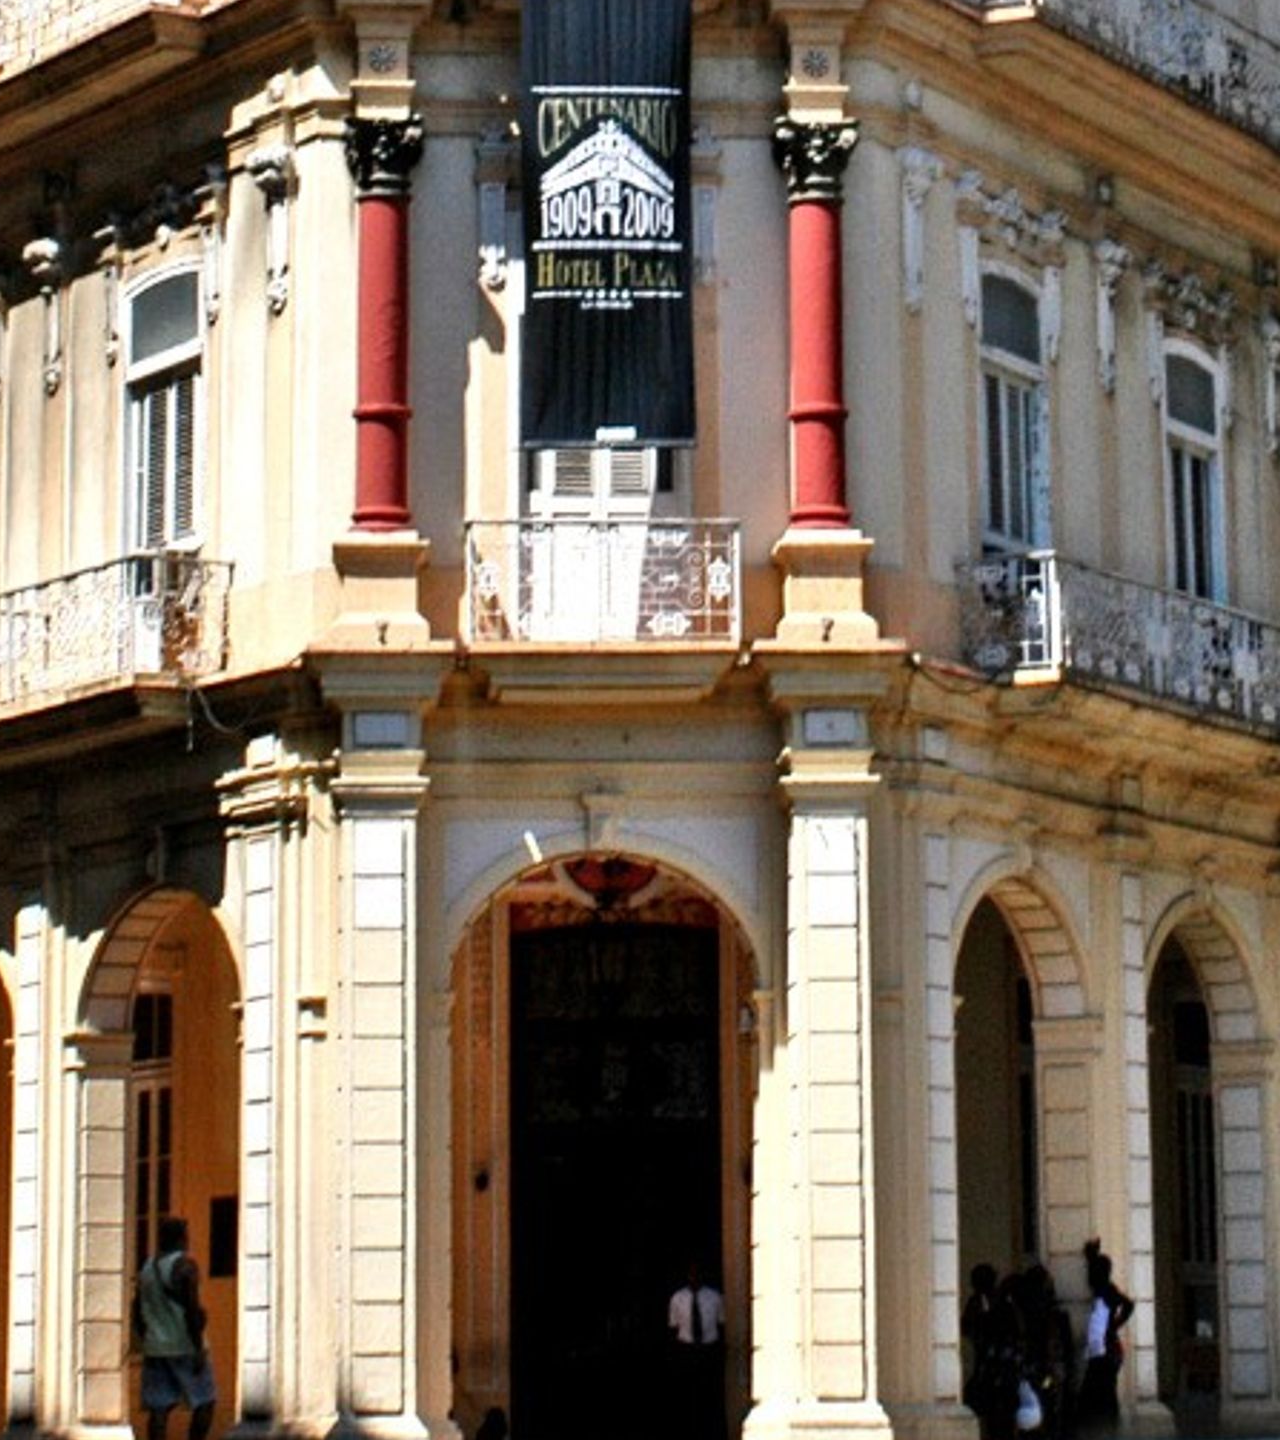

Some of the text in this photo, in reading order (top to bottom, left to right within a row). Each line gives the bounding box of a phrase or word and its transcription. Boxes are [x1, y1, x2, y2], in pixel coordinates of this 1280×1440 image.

[537, 96, 678, 158] CENTENARIO
[541, 184, 674, 239] 1909 2009
